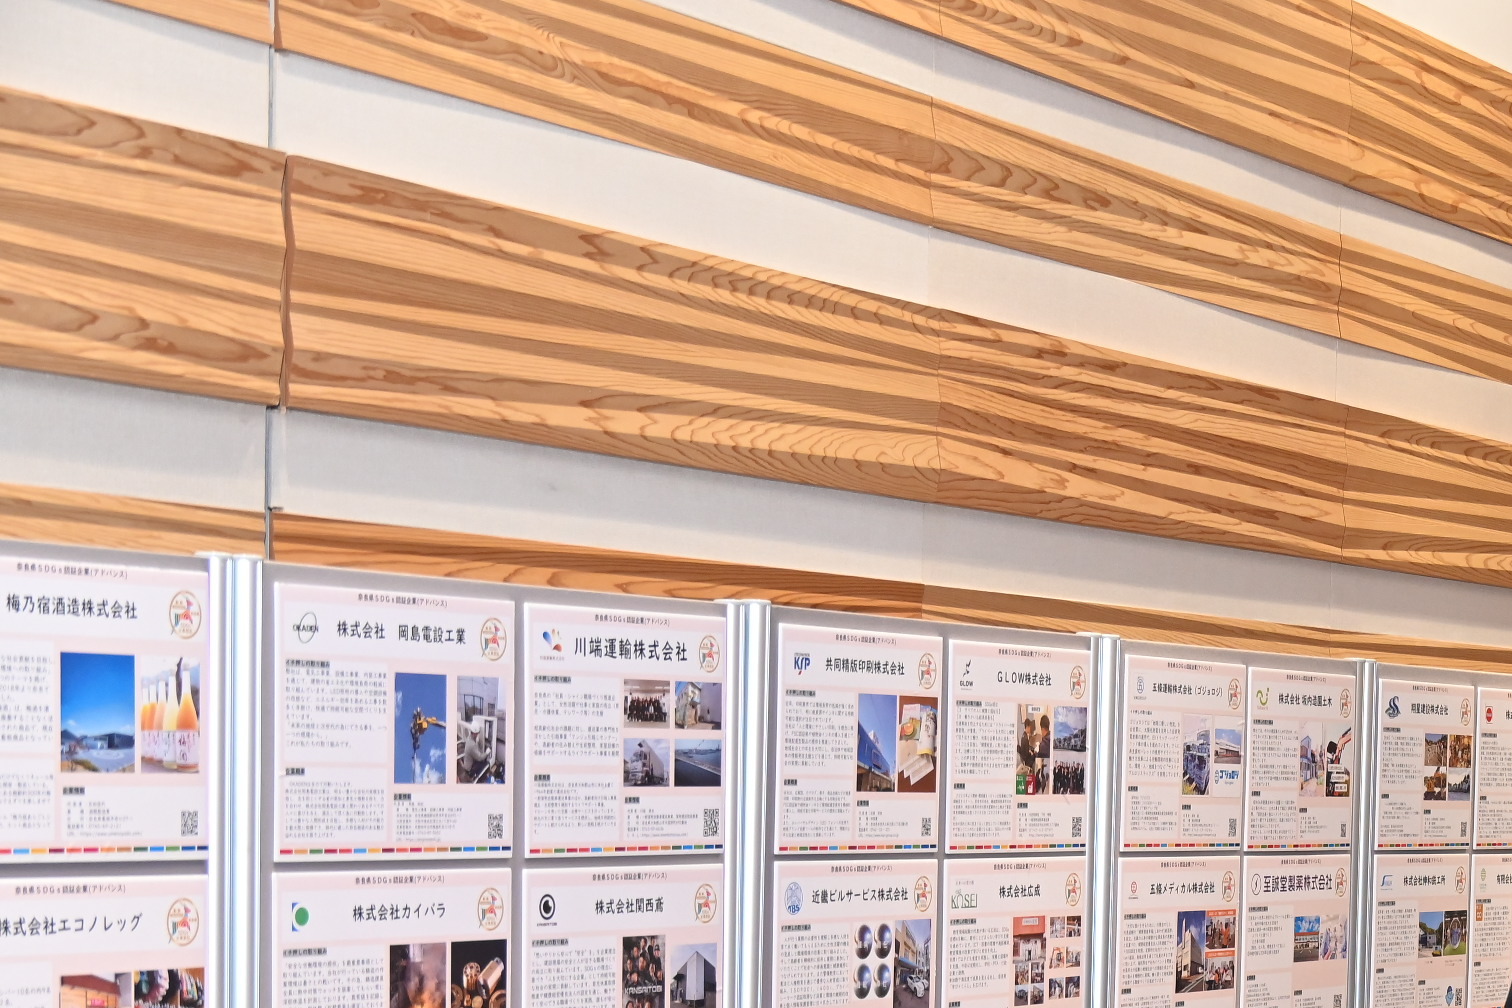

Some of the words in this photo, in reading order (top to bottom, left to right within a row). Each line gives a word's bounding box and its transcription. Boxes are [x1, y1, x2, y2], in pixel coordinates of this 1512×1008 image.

[6, 593, 138, 620] 梅乃宿酒造株式会社
[337, 620, 386, 641] 株式会社
[398, 624, 467, 645] 岡島電設工業
[574, 636, 688, 662] 川端運輸株式会社
[825, 657, 905, 676] 共同精版印刷株式会社
[997, 671, 1052, 686] GLOW株式会社
[1279, 692, 1301, 705] 株式会社
[999, 884, 1041, 898] 株式会社広成
[1263, 874, 1333, 893] 至誠堂製薬株式会社
[811, 886, 909, 905] 近畿ビルサービス株式会社
[353, 903, 446, 923] 株式会社カイバラ
[595, 896, 664, 915] 株式会社関西鳶
[0, 912, 143, 937] 株式会社エコノレッグ
[624, 984, 663, 996] KANSAITOBI
